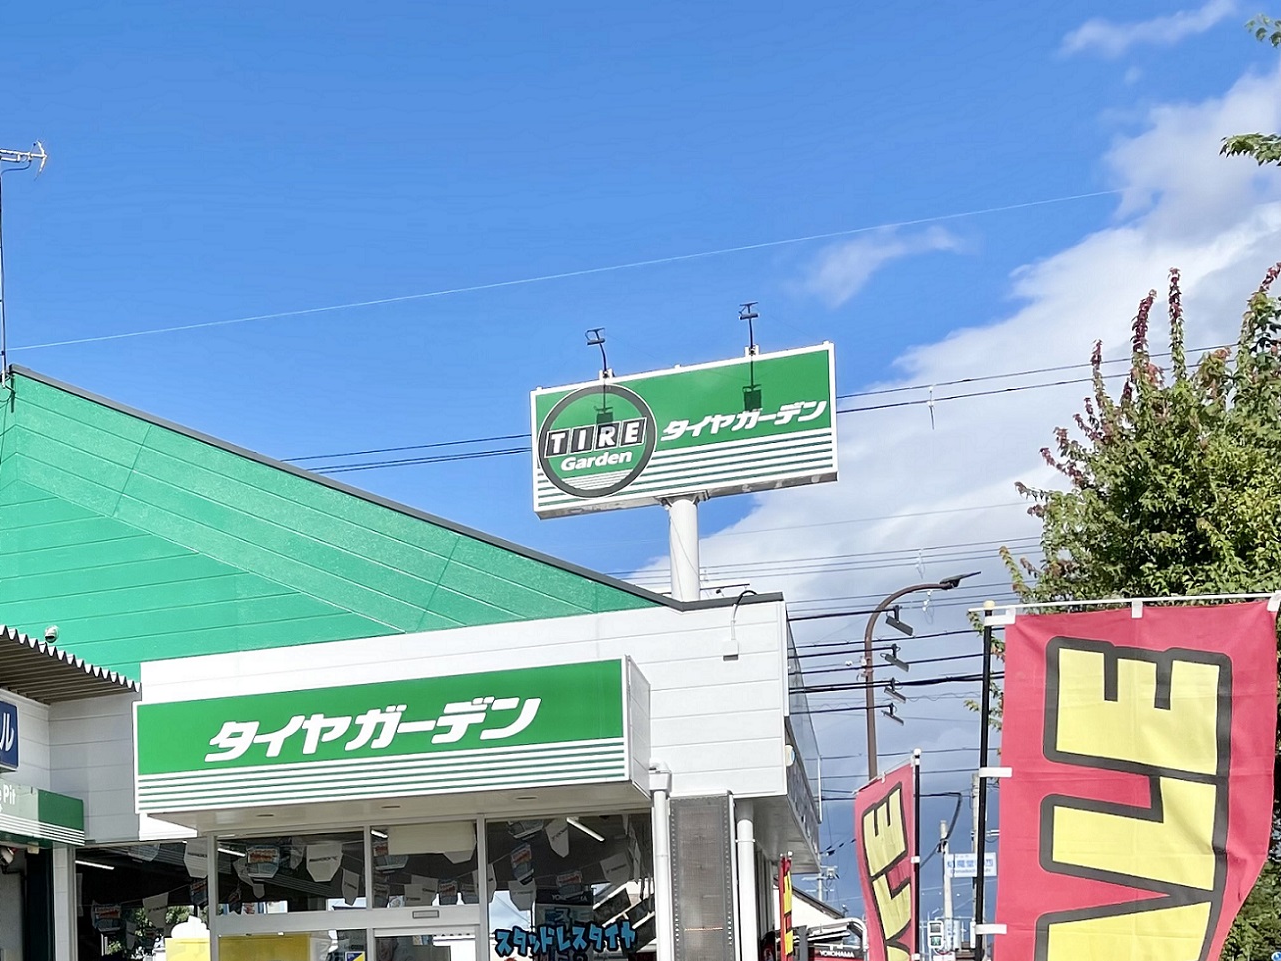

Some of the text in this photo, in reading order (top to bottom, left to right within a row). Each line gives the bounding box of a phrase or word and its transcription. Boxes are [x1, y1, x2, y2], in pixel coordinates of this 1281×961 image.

[661, 400, 827, 441] タイヤガーデン
[550, 421, 640, 455] TIRE
[560, 451, 632, 471] Garden
[204, 697, 543, 762] タイヤガーデン
[3, 786, 17, 804] Pit
[495, 921, 636, 956] スタッドレスタイヤ
[820, 950, 855, 958] YOKOHAMA
